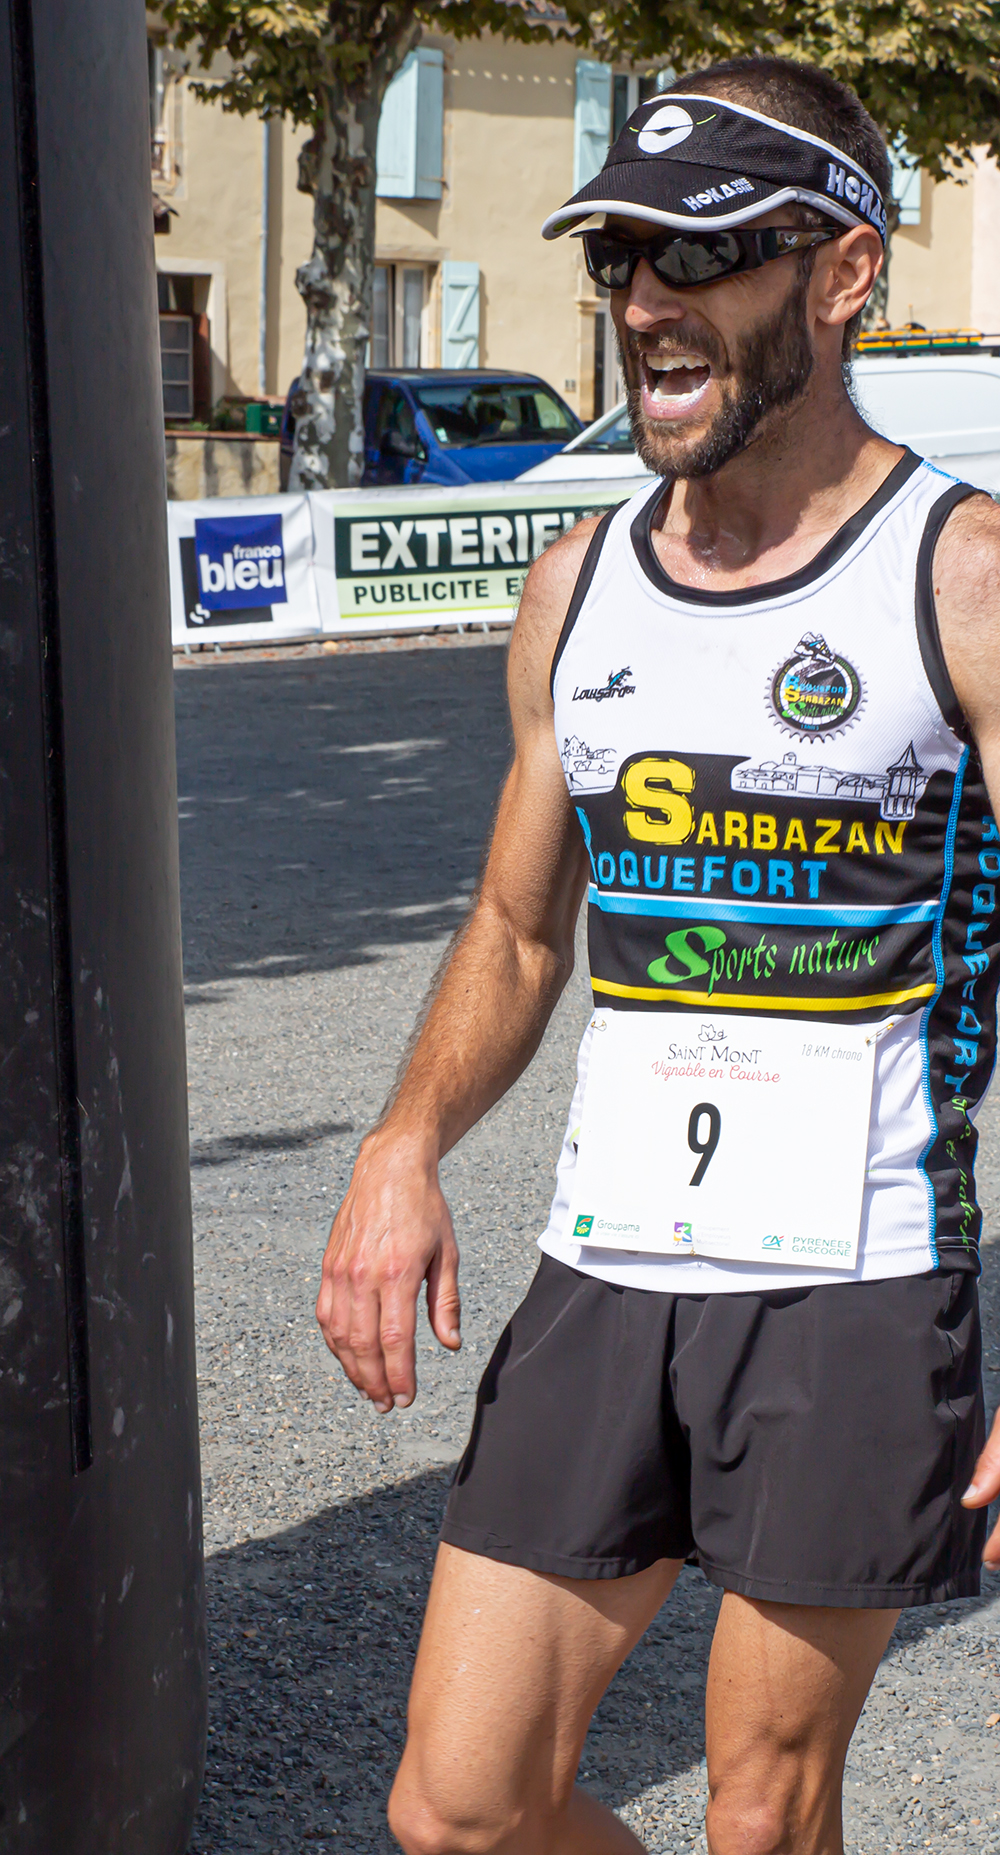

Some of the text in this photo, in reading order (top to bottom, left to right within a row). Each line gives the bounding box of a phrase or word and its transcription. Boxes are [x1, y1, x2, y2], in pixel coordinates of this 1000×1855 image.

[682, 184, 738, 212] HOKA
[826, 163, 882, 229] HOKA
[233, 543, 282, 560] france
[350, 510, 606, 571] EXTERIE
[199, 553, 284, 593] bleu
[353, 578, 490, 605] PUBLICITE
[621, 757, 907, 855] SARBAZAN
[647, 925, 880, 998] Sports nature
[711, 1045, 762, 1064] MONT
[801, 1043, 863, 1062] 18 KM chrono
[651, 1060, 781, 1083] Vignoble en Course
[687, 1102, 722, 1187] 9
[597, 1219, 641, 1233] Groupama
[791, 1245, 851, 1257] GASCOGNE
[792, 1236, 852, 1249] PYRÉNÉES
